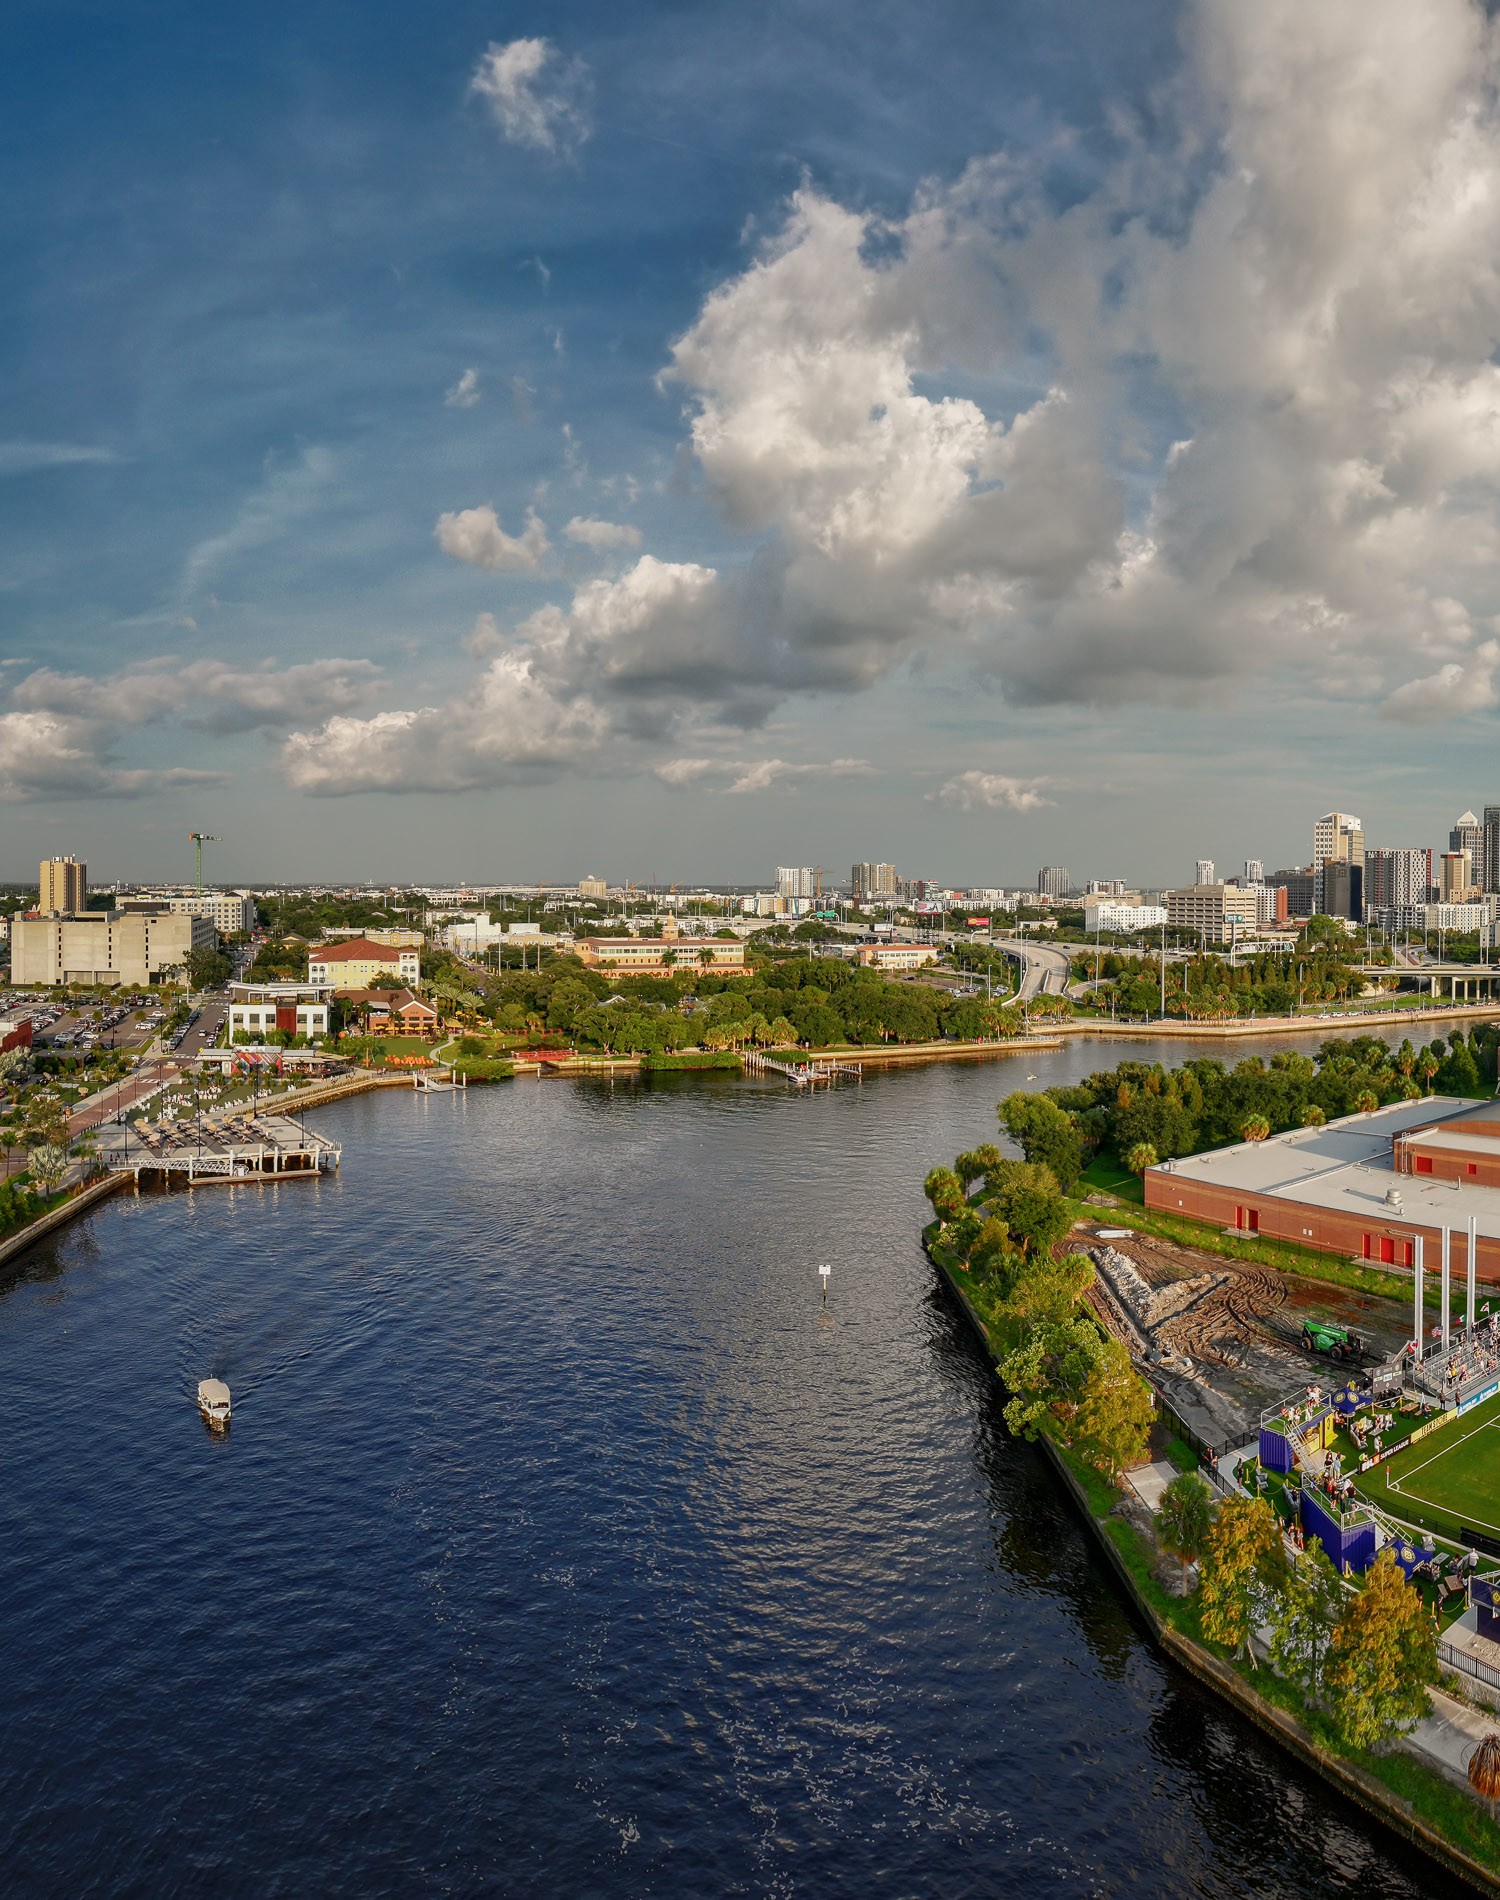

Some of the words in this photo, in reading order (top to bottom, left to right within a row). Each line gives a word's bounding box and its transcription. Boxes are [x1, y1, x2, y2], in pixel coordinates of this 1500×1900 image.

[1421, 1423, 1433, 1435] TEAM
[1380, 1449, 1393, 1460] SUPER
[1394, 1439, 1409, 1452] LEAGUE
